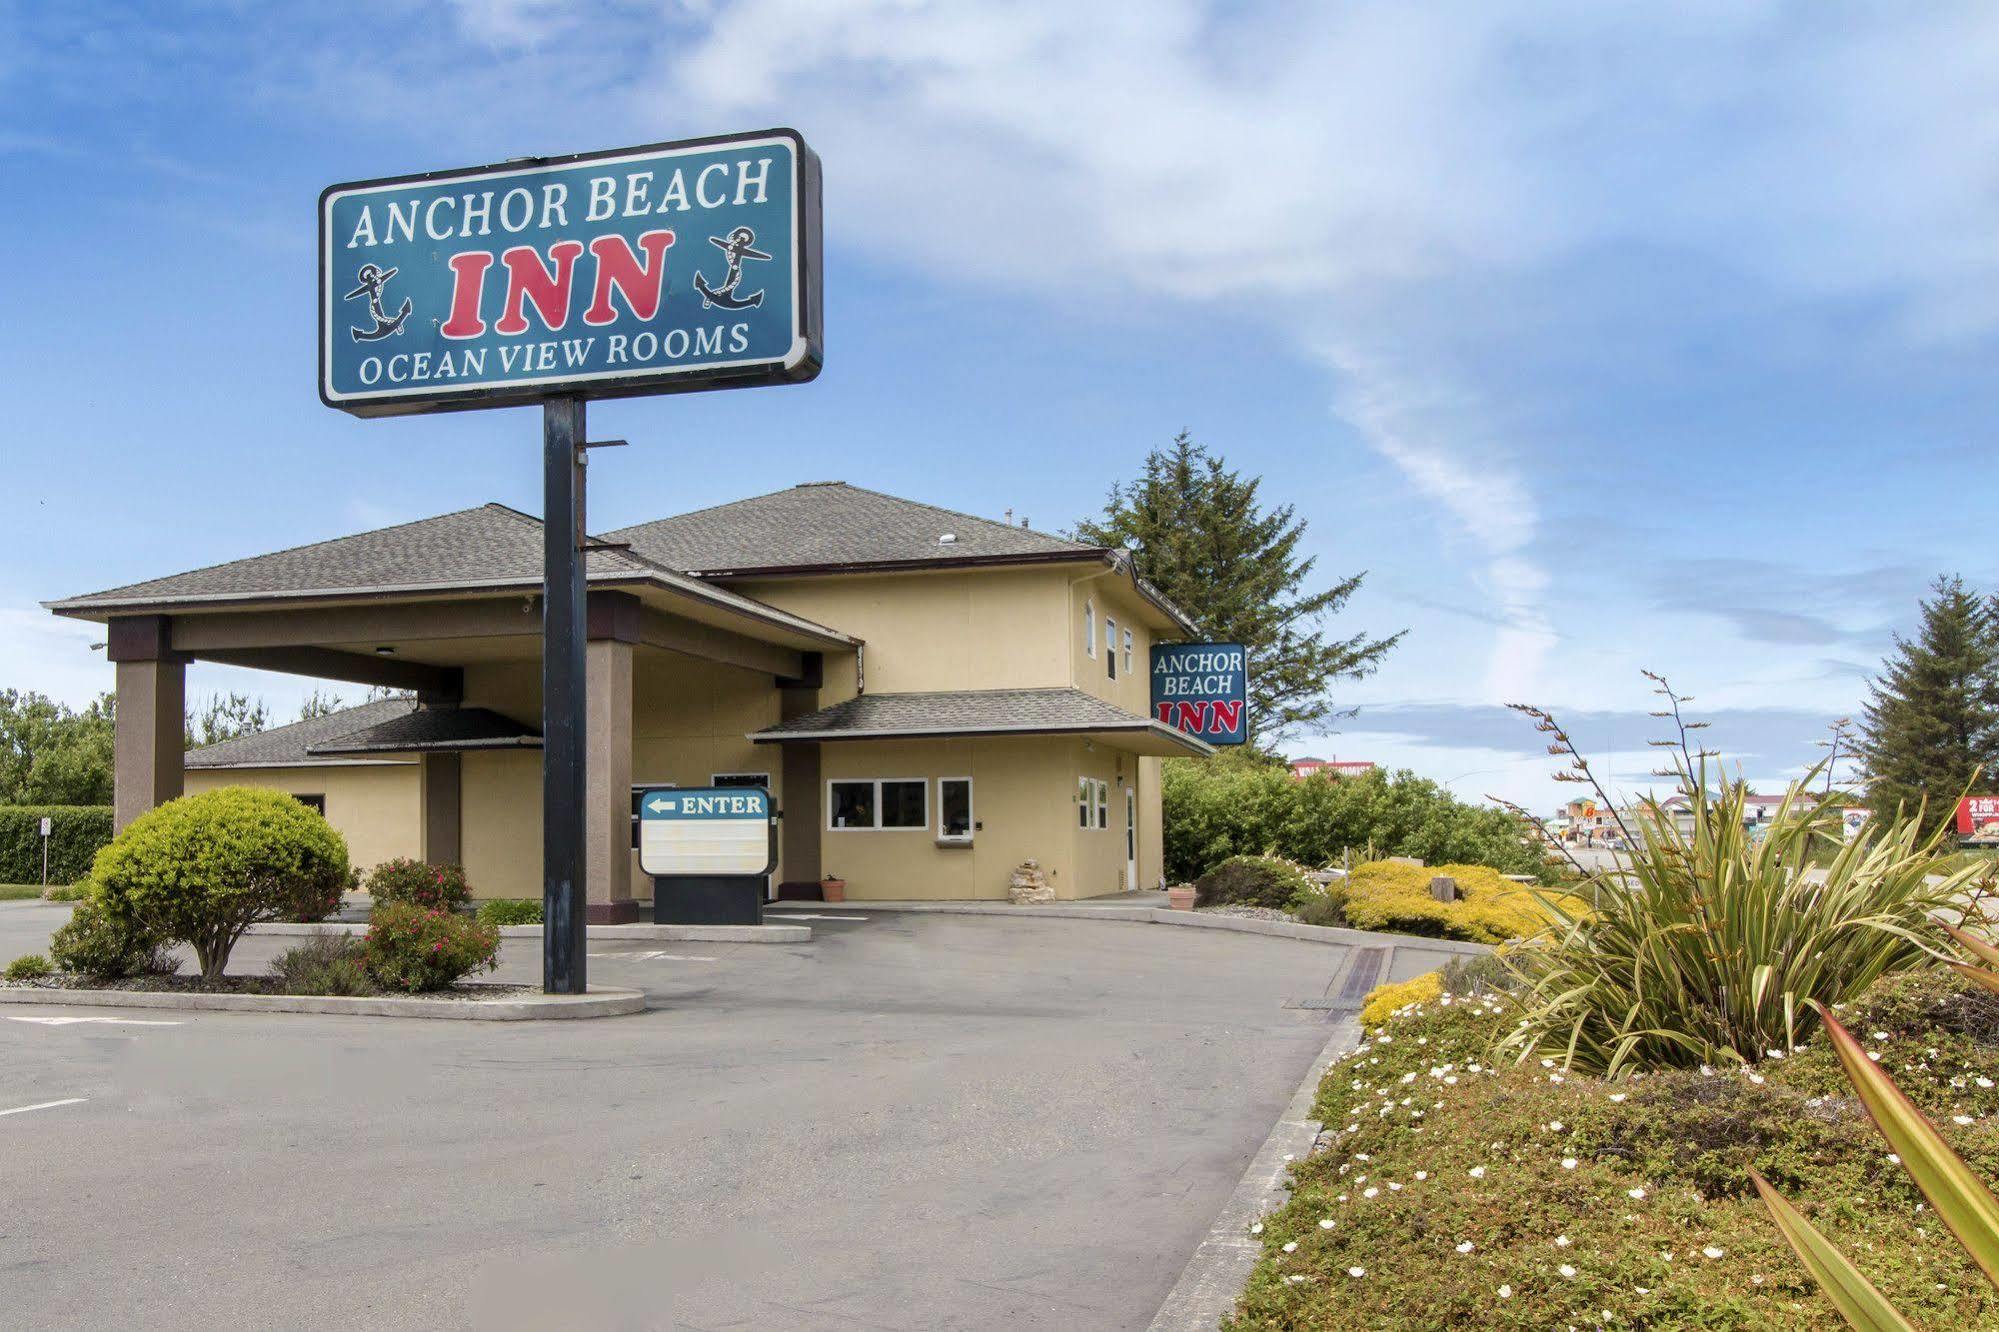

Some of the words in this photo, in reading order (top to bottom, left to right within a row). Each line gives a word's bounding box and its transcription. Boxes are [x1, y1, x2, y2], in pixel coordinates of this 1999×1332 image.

[347, 185, 569, 249] ANCHOR
[586, 159, 772, 222] BEACH
[440, 230, 676, 340] INN
[359, 348, 488, 385] OCEAN
[498, 338, 595, 373] VIEW
[607, 323, 750, 364] ROOMS
[1154, 652, 1242, 673] ANCHOR
[1163, 675, 1232, 695] BEACH
[1157, 700, 1243, 734] INN
[682, 796, 763, 814] ENTER
[1969, 799, 1978, 812] 2
